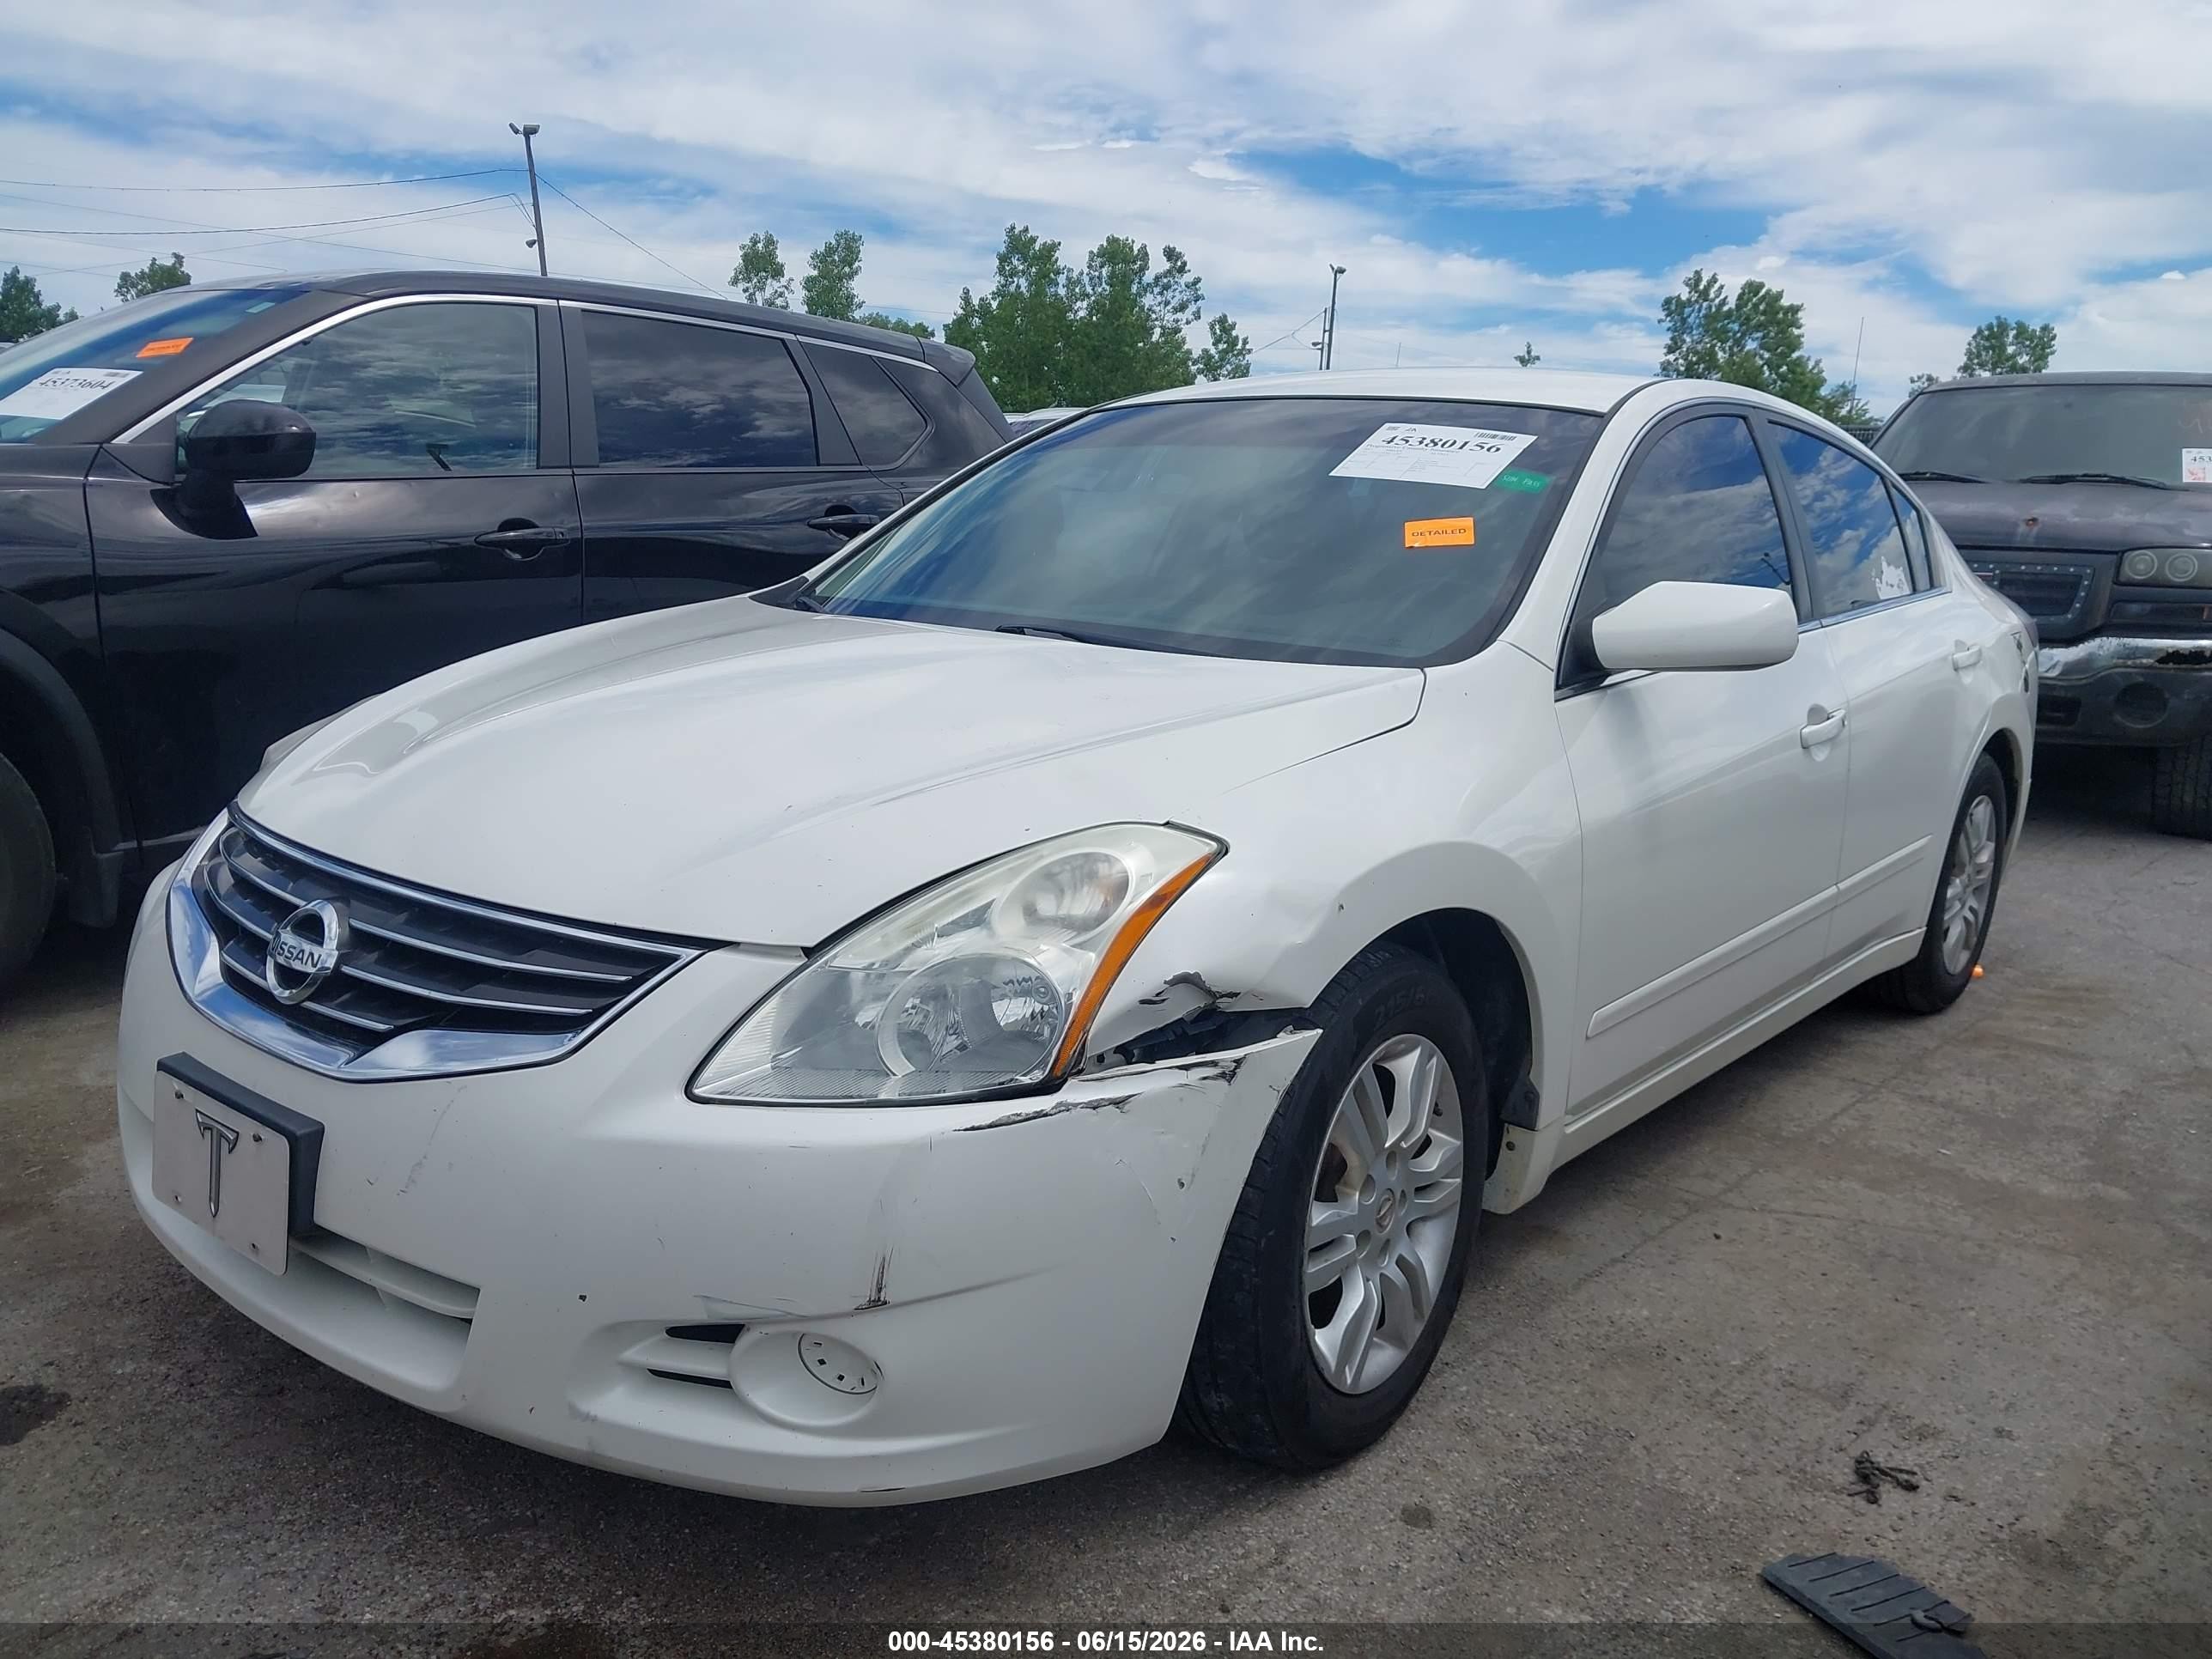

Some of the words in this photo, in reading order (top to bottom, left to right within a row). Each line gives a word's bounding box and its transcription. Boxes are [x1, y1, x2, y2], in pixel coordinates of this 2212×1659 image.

[40, 378, 116, 390] 45373604
[1382, 434, 1505, 453] 45380156
[1411, 527, 1468, 537] DETAILED
[270, 935, 322, 969] NISSAN
